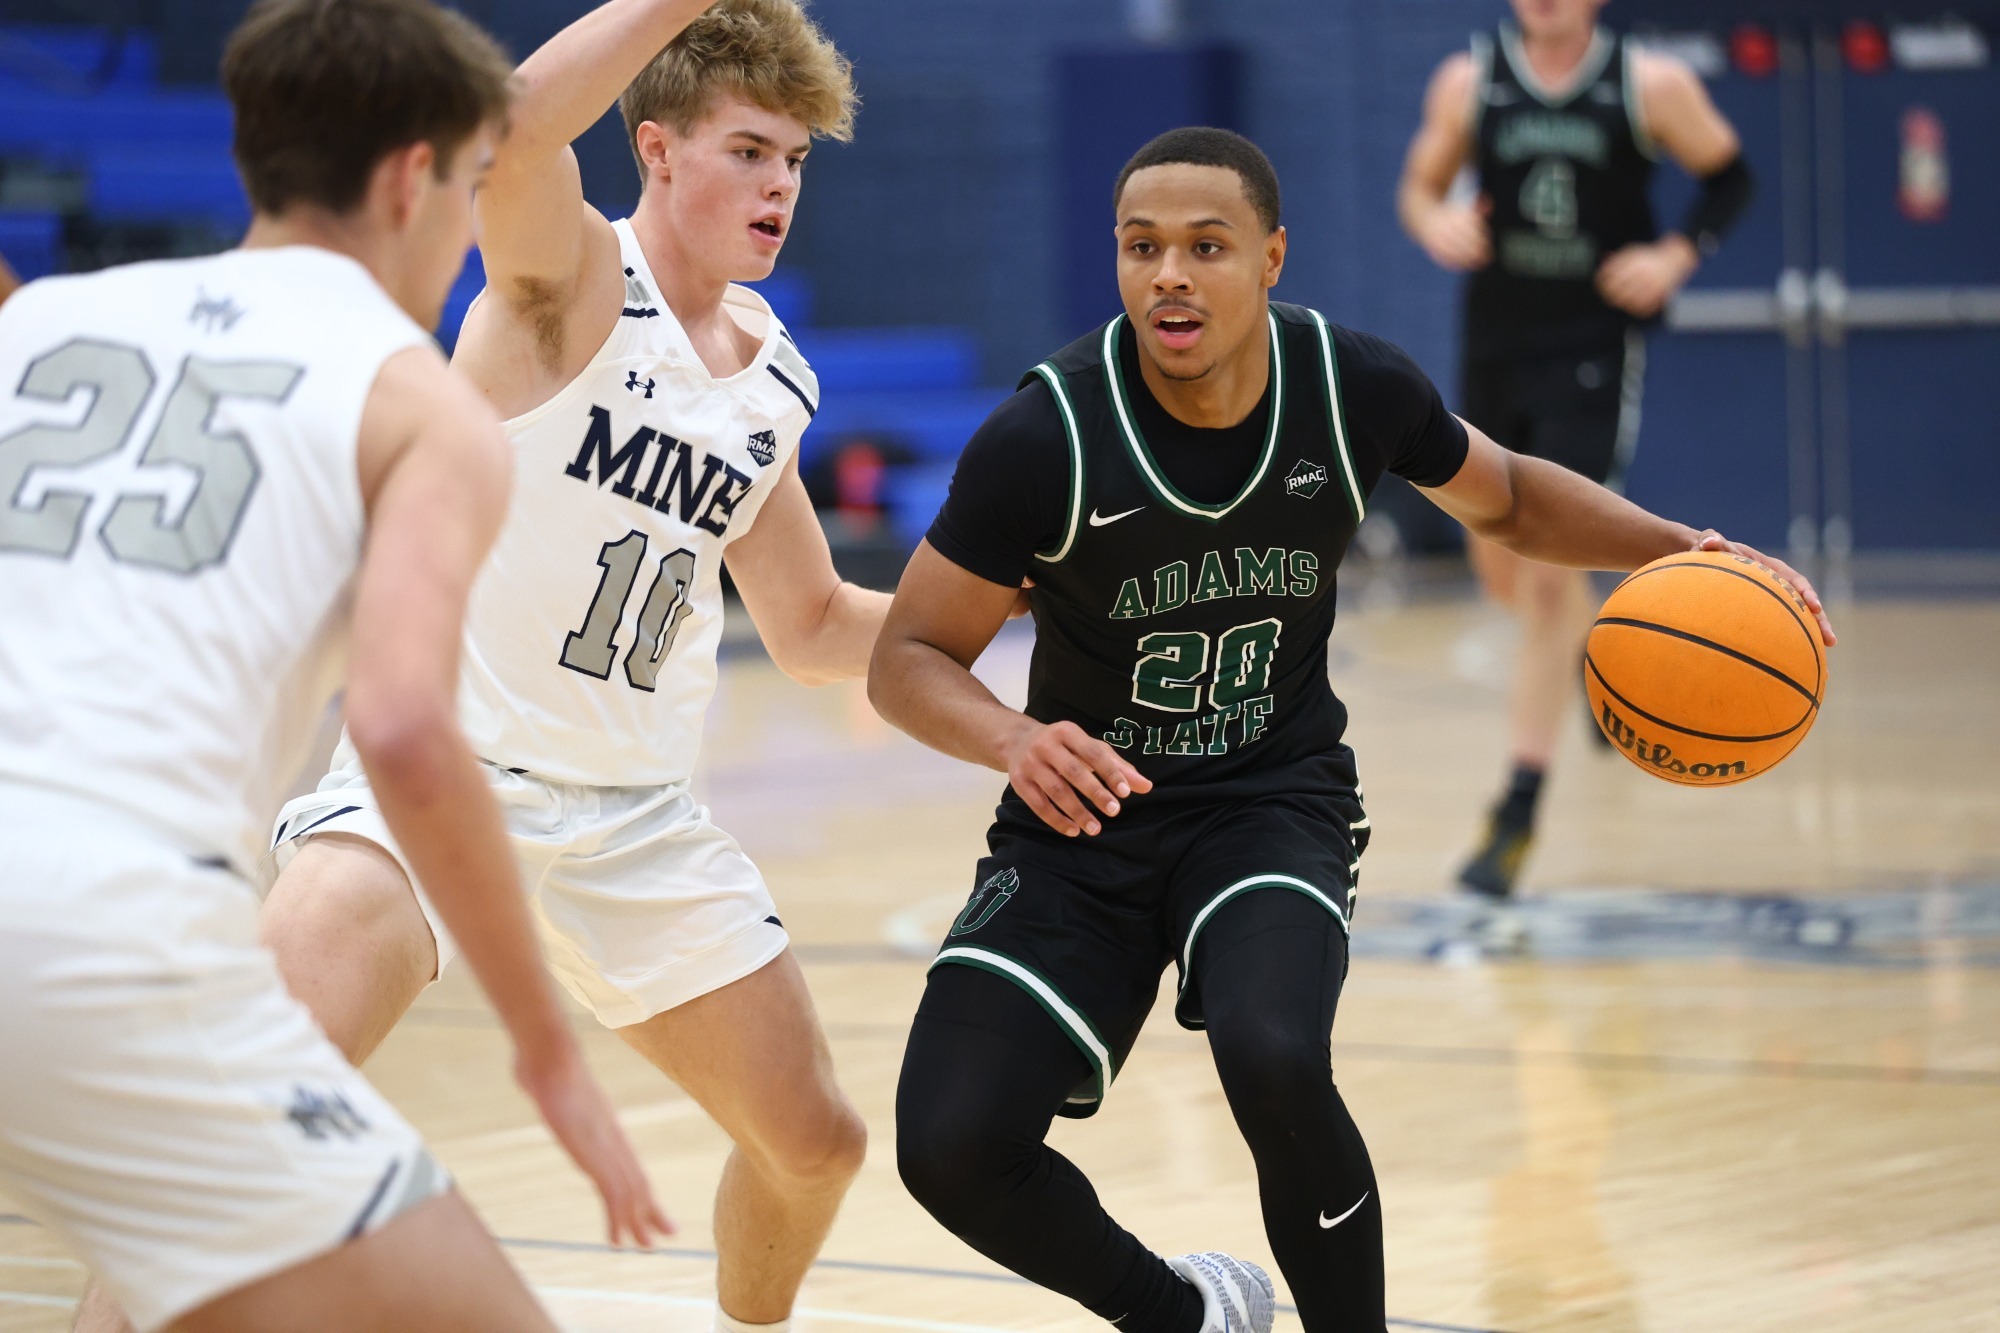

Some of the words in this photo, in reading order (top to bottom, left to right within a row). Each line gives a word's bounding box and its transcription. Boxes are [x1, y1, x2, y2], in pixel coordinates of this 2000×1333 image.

[0, 336, 307, 577] 25
[563, 402, 753, 538] MINE
[748, 437, 776, 458] RMA
[1289, 469, 1325, 491] RMAC
[557, 529, 696, 693] 10
[1109, 547, 1319, 619] ADAMS
[1131, 617, 1283, 713] 20
[1601, 699, 1747, 778] Wilson
